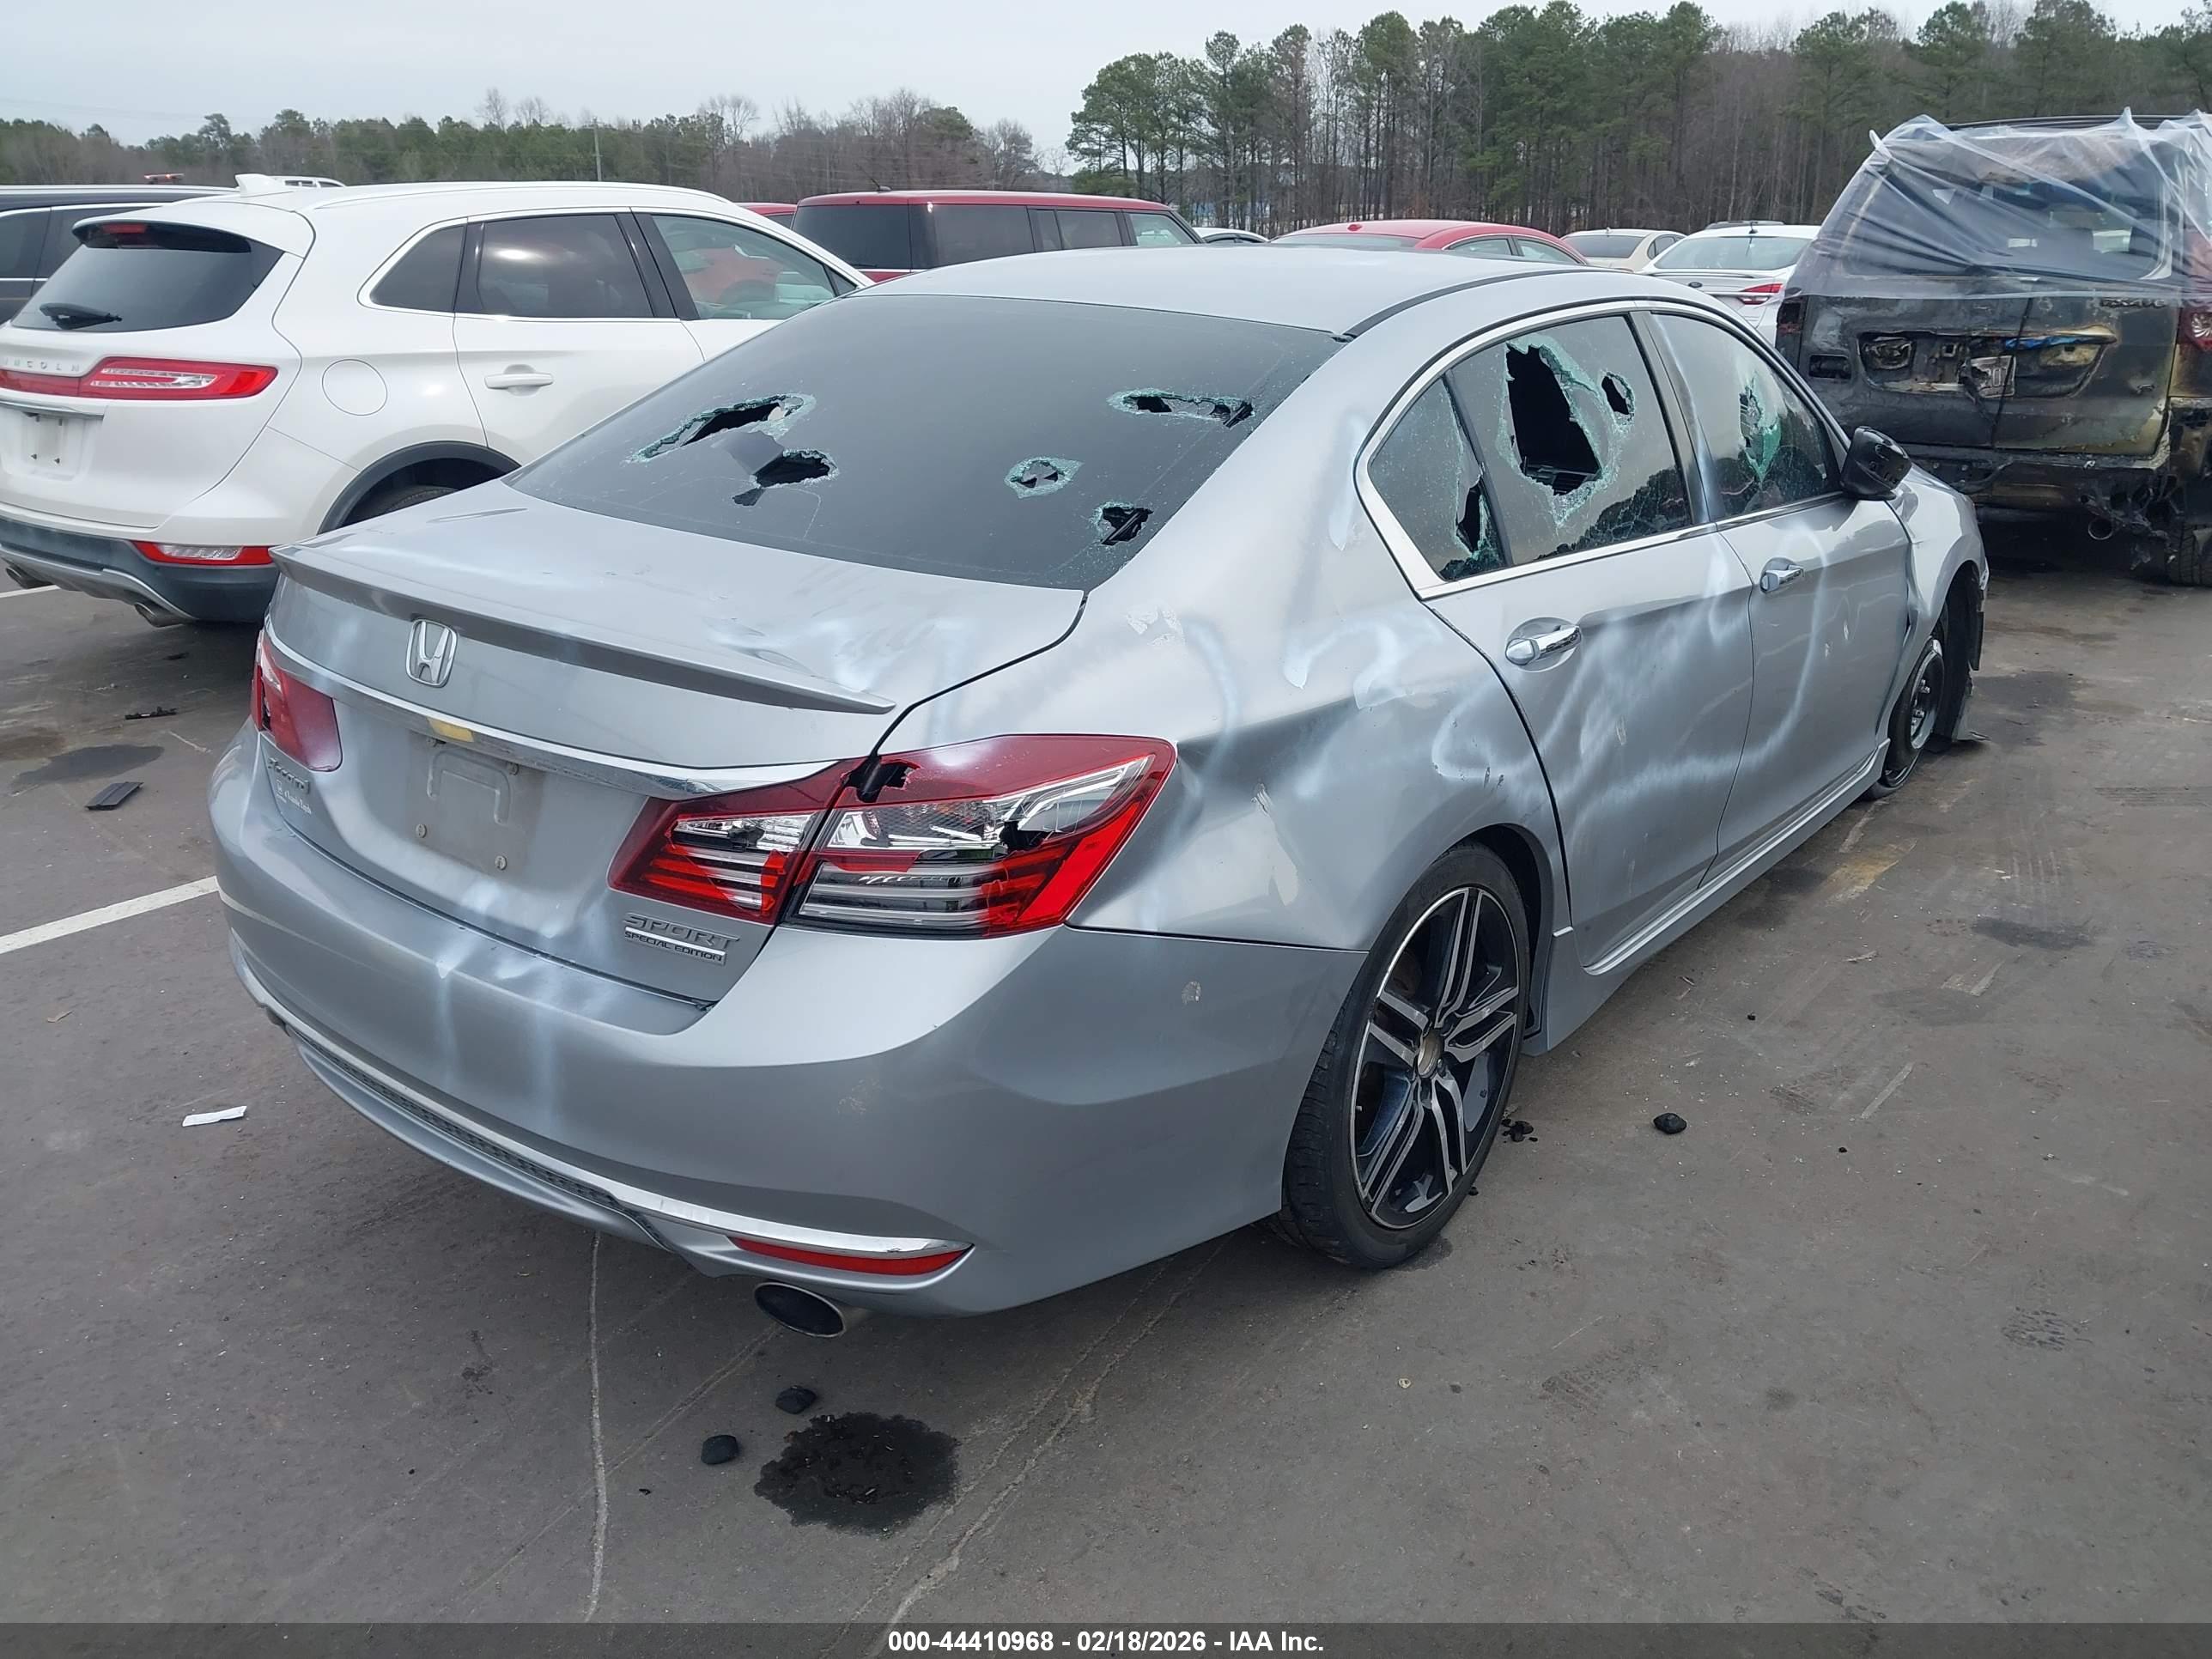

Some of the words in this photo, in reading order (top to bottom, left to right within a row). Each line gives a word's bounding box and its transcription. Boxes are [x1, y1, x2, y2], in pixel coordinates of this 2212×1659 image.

[3, 356, 80, 372] INCOLN
[623, 913, 739, 949] SPORT
[624, 931, 672, 950] SPECIAL
[675, 944, 723, 962] EDITION
